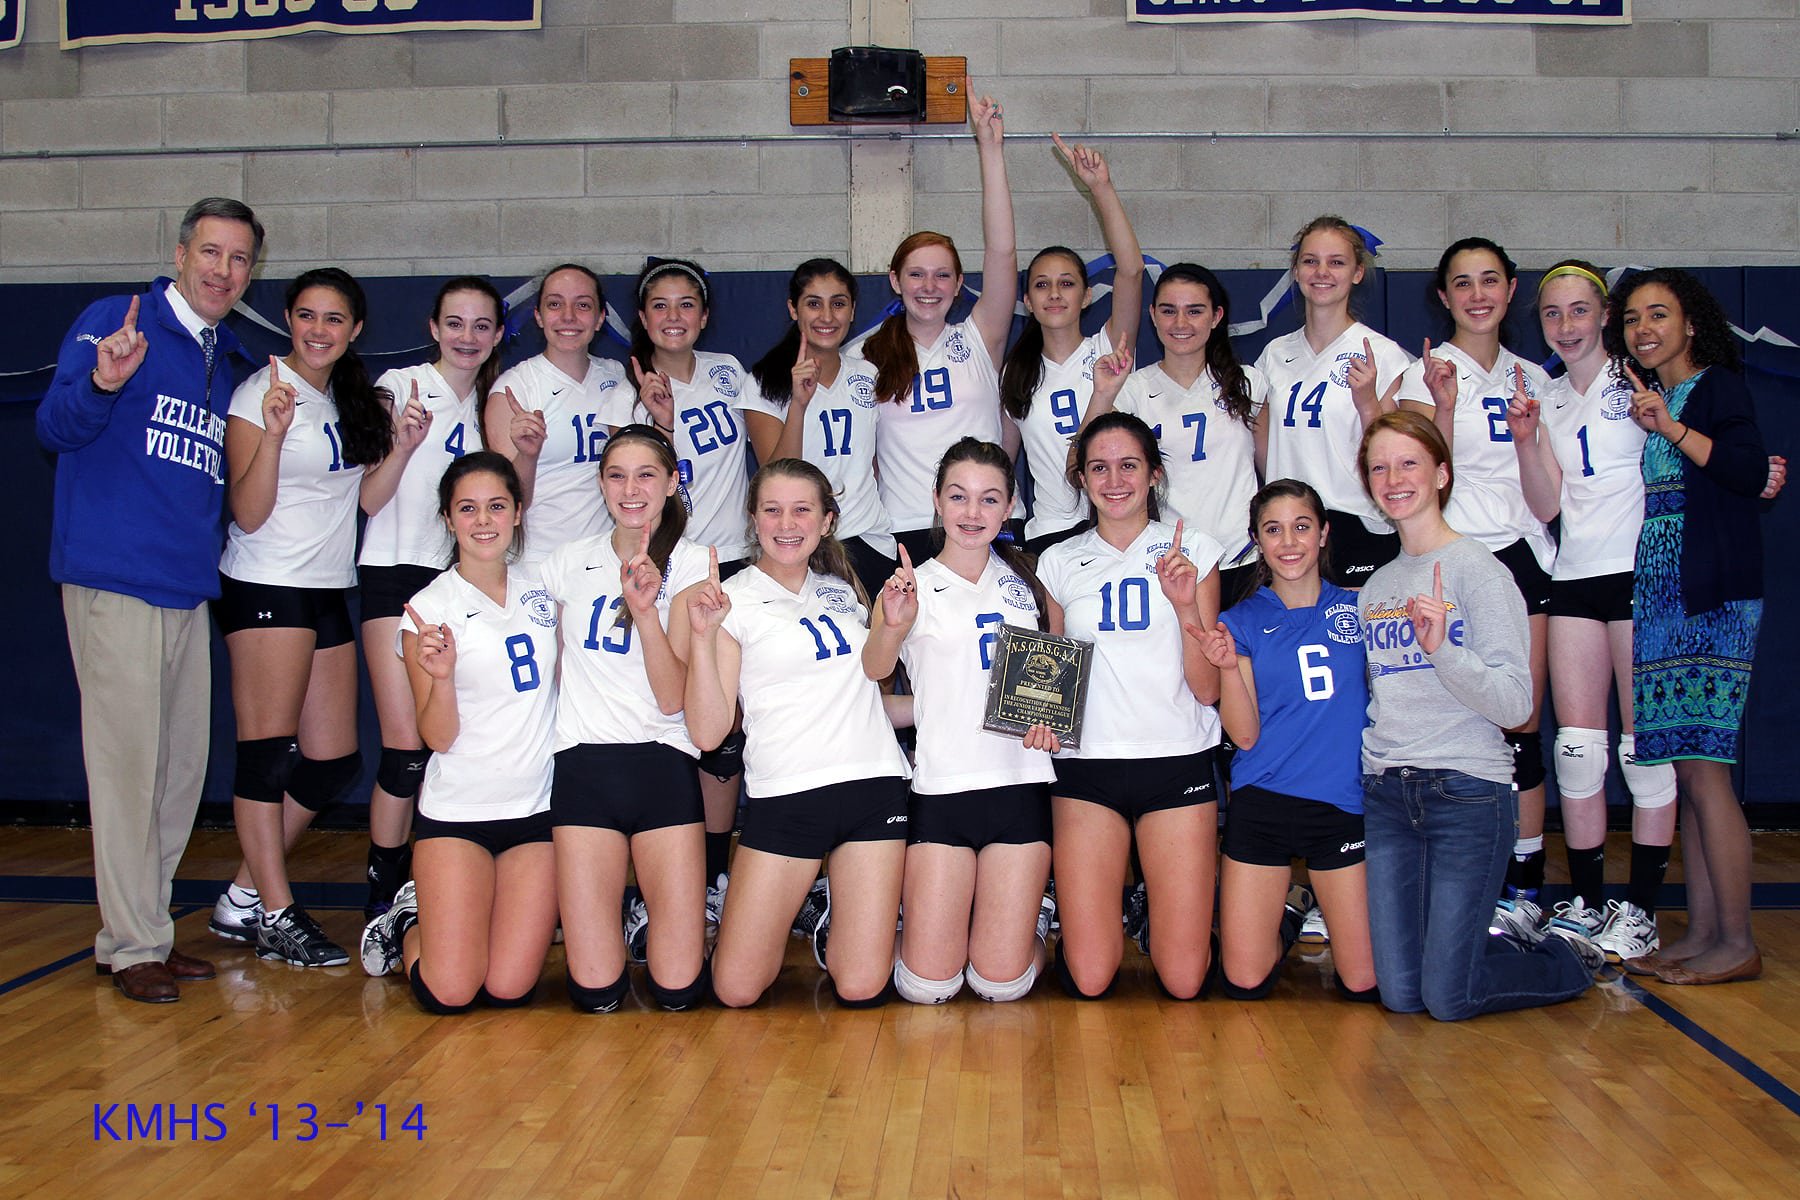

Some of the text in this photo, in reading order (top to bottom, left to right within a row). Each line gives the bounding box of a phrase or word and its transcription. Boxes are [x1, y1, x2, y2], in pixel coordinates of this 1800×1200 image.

[911, 366, 953, 413] 19
[1049, 388, 1081, 434] 9
[1282, 381, 1328, 428] 14
[444, 421, 466, 461] 4
[571, 413, 609, 463] 12
[680, 400, 739, 455] 20
[819, 408, 853, 457] 17
[1182, 412, 1207, 462] 7
[1481, 396, 1514, 442] 2
[323, 421, 358, 472] 1
[1576, 425, 1595, 477] 1
[583, 594, 632, 655] 13
[1098, 577, 1150, 631] 10
[800, 614, 852, 661] 11
[505, 633, 541, 693] 8
[1020, 680, 1052, 691] PRESNTED
[1297, 644, 1334, 701] 6
